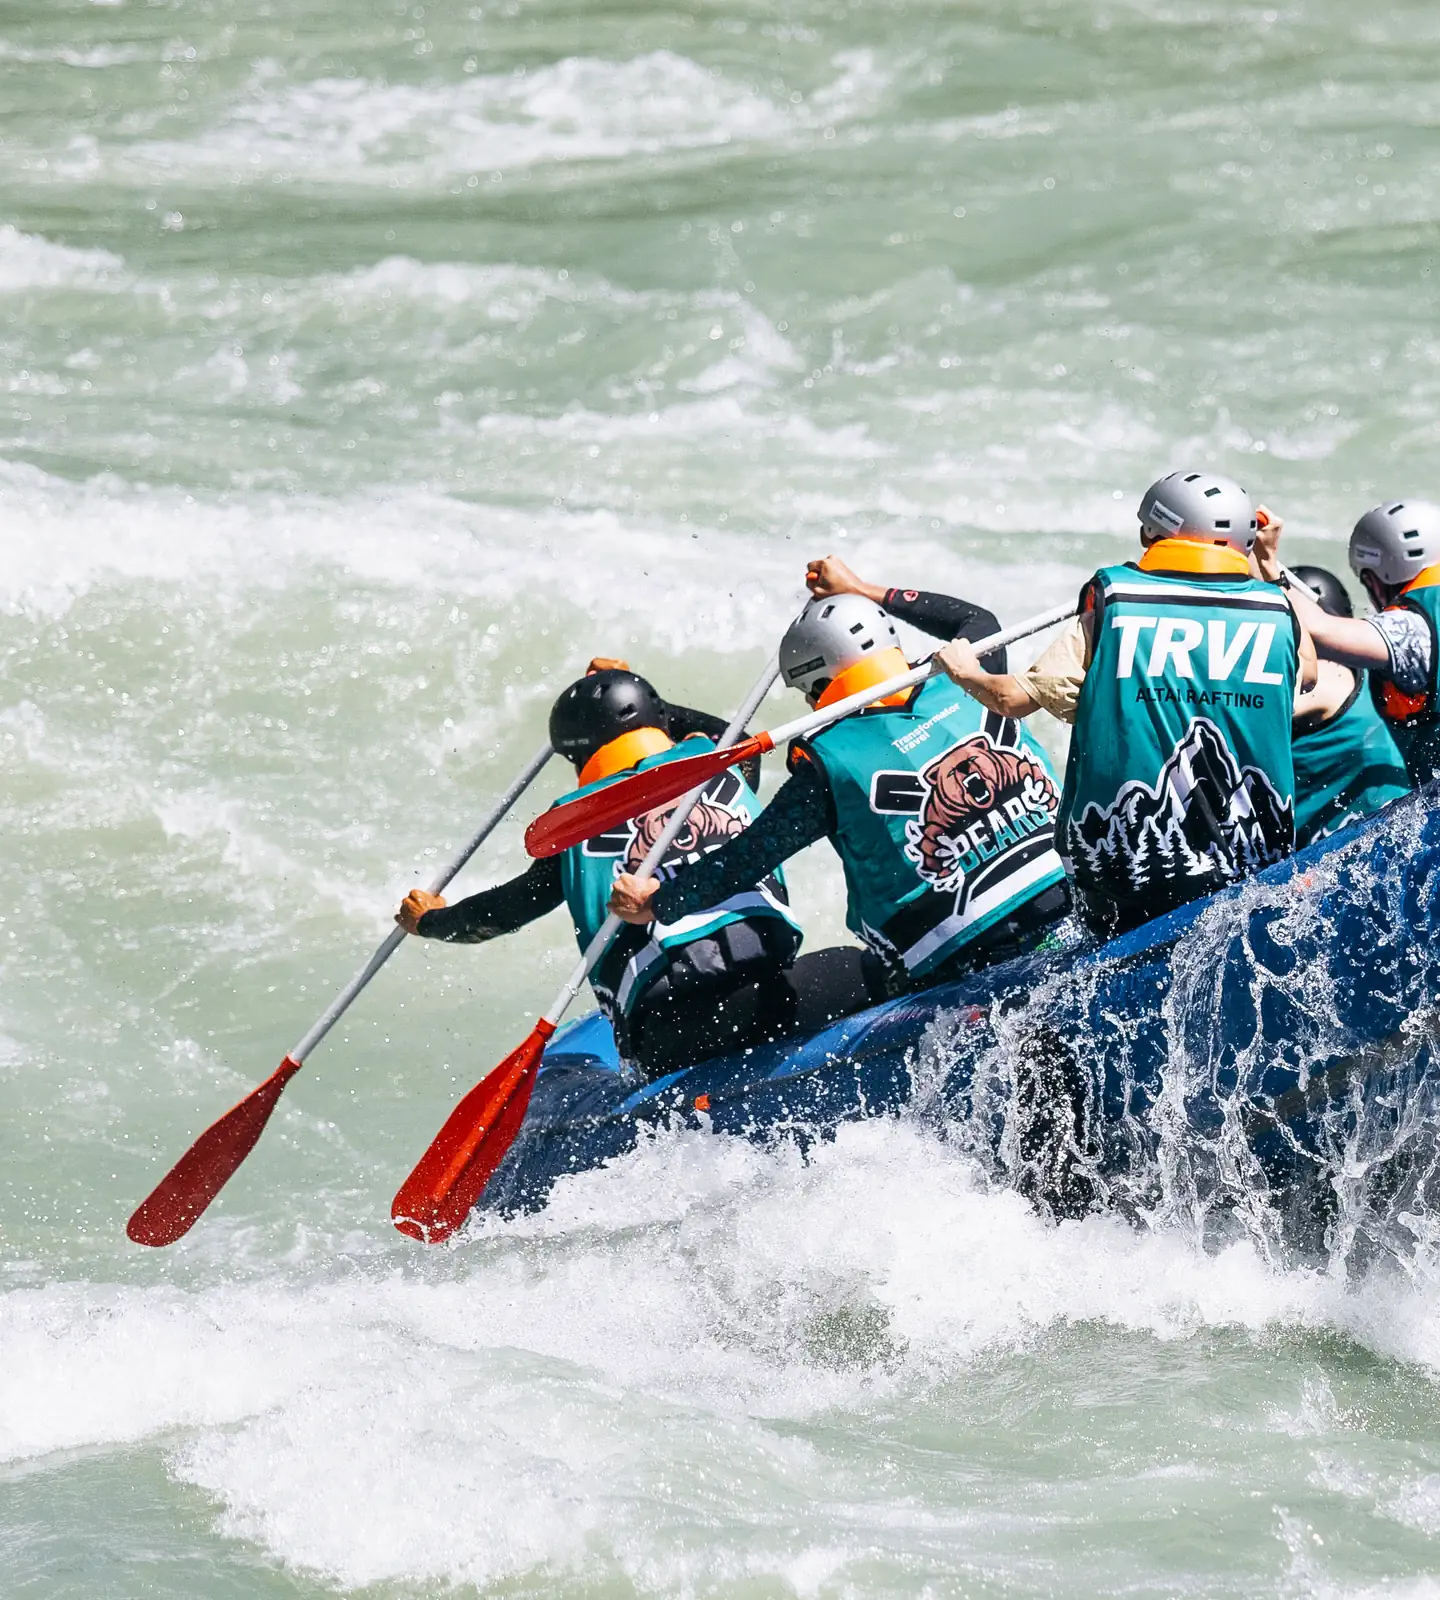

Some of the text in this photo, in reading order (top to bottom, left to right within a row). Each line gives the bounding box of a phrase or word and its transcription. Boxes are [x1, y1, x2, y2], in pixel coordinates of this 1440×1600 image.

[1112, 615, 1284, 686] TRVL
[1136, 687, 1265, 709] ALTAI RAFTING
[891, 703, 960, 749] Transformator
[899, 728, 931, 754] travel
[952, 796, 1050, 874] BEARS
